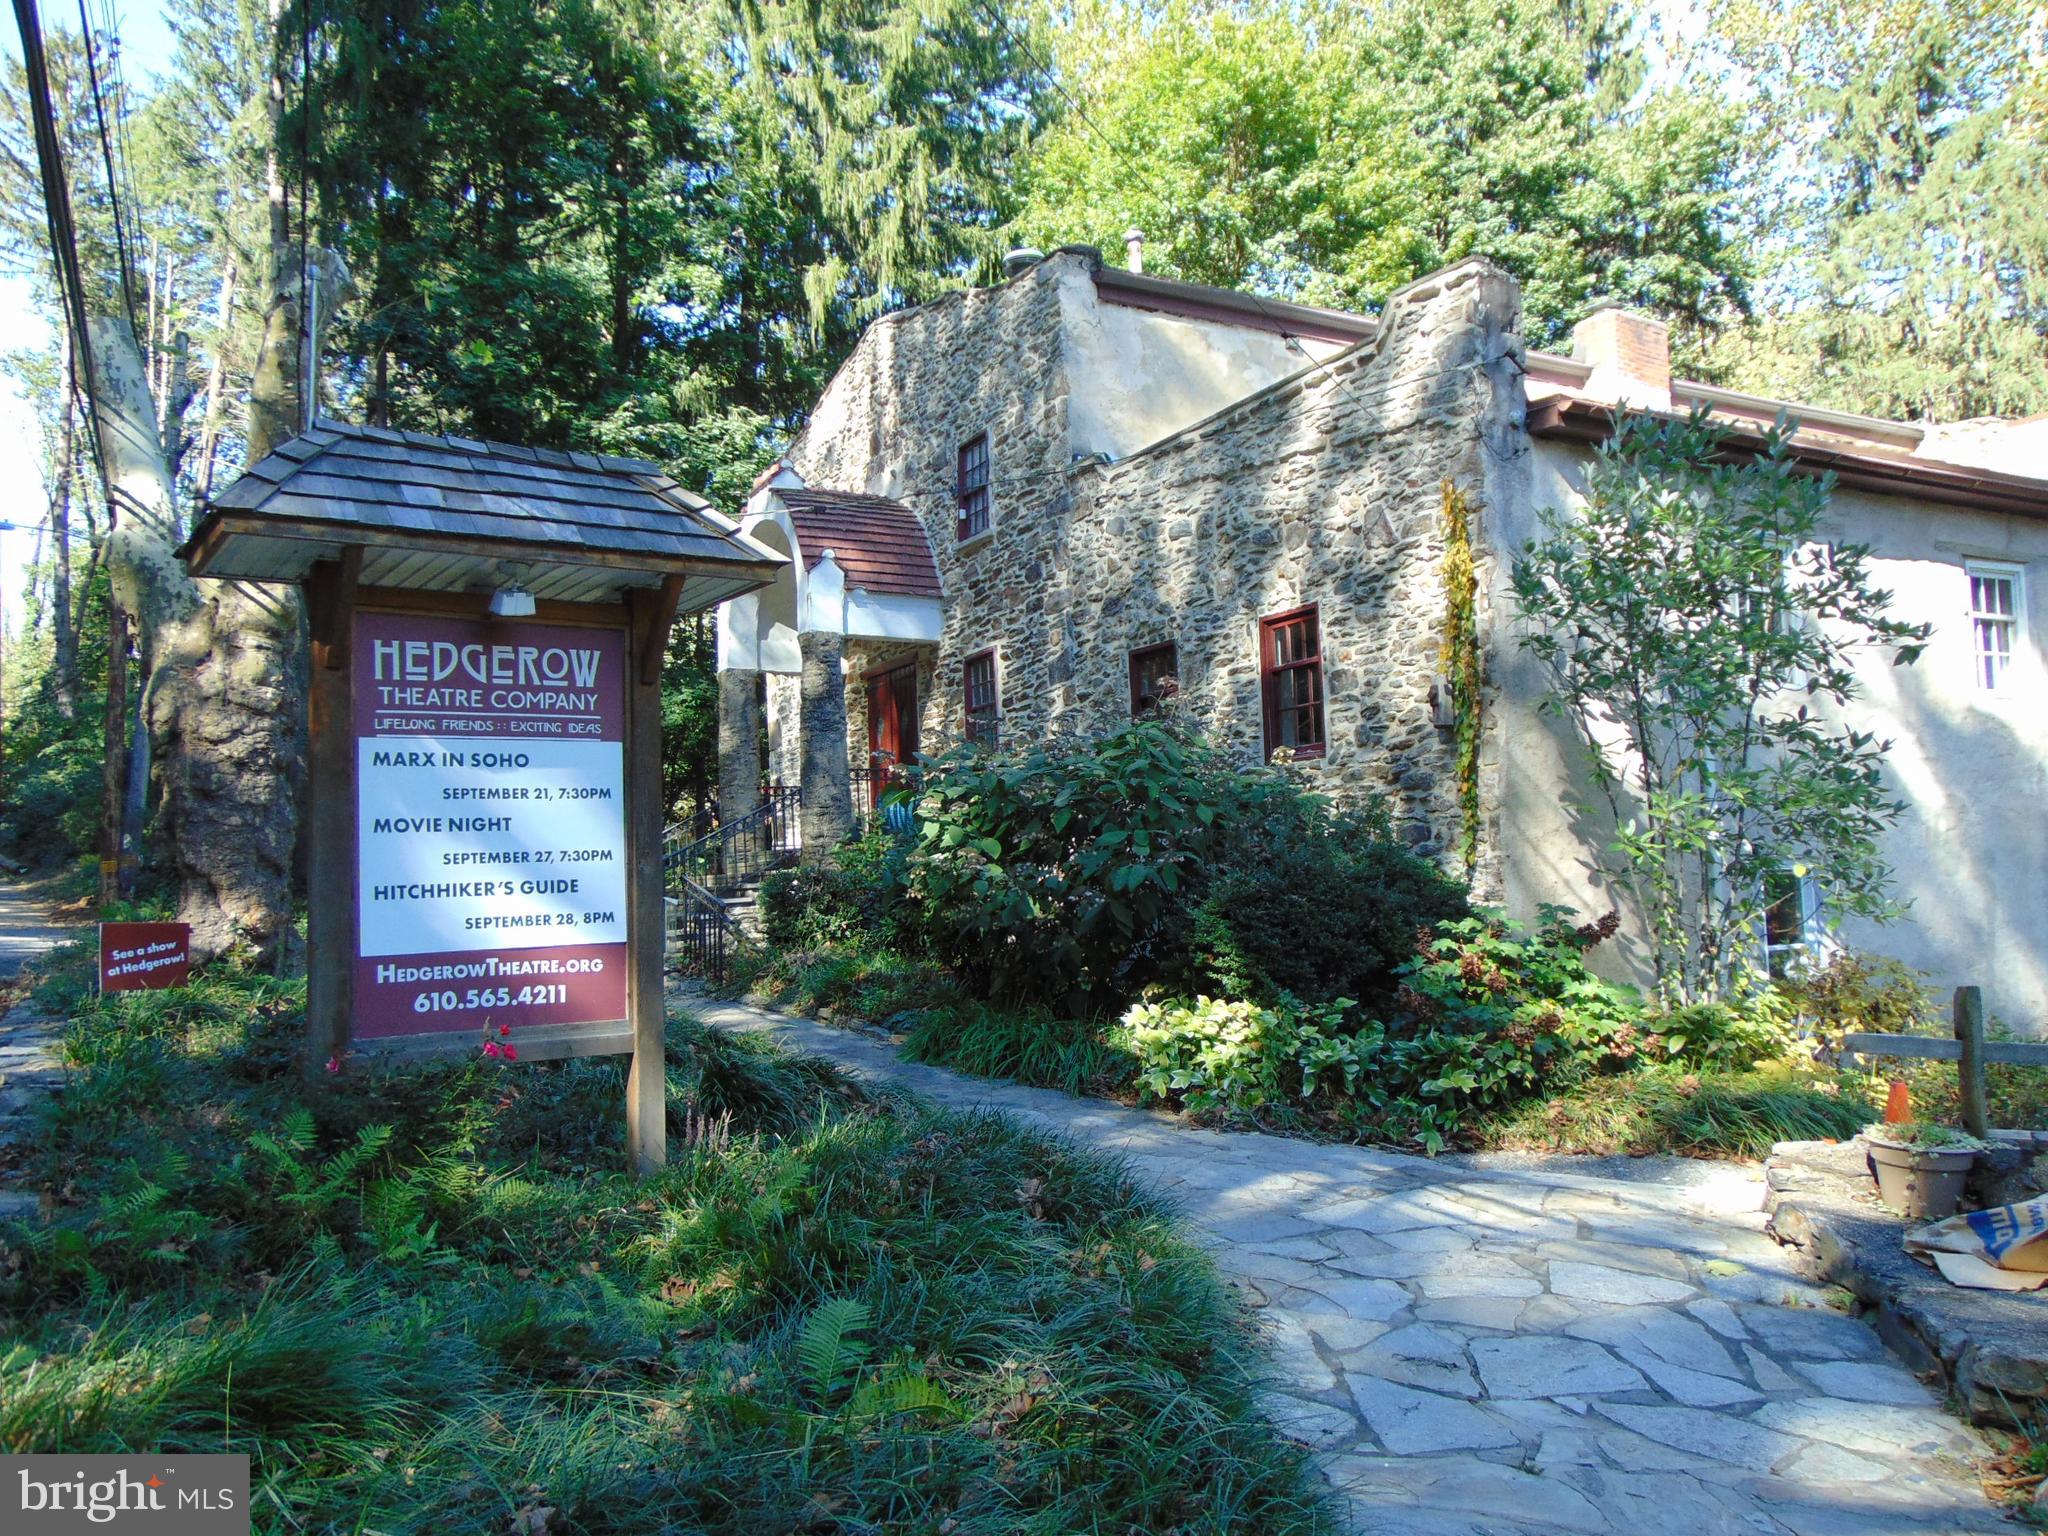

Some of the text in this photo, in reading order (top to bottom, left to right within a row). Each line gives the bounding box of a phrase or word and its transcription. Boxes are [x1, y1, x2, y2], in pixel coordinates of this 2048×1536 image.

[374, 639, 601, 687] HEDGEROW
[378, 687, 598, 711] THEATRE COMPANY
[375, 718, 435, 730] LIFELONG
[442, 719, 494, 731] FRIENDS
[511, 721, 561, 733] EXCITING
[568, 722, 602, 734] IDEAS
[372, 752, 529, 768] MARX IN SOHO
[442, 788, 611, 802] SEPTEMBER 21, 7:30PM
[373, 817, 512, 833] MOVIE NIGHT
[443, 850, 613, 865] SEPTEMBER 27, 7:30PM
[374, 879, 579, 901] HITCHHIKER'S GUIDE
[465, 912, 615, 930] SEPTEMBER 28, 8PM
[111, 941, 177, 961] See a show
[107, 952, 185, 977] at Hedgerow!
[413, 984, 567, 1014] 610.565.4211
